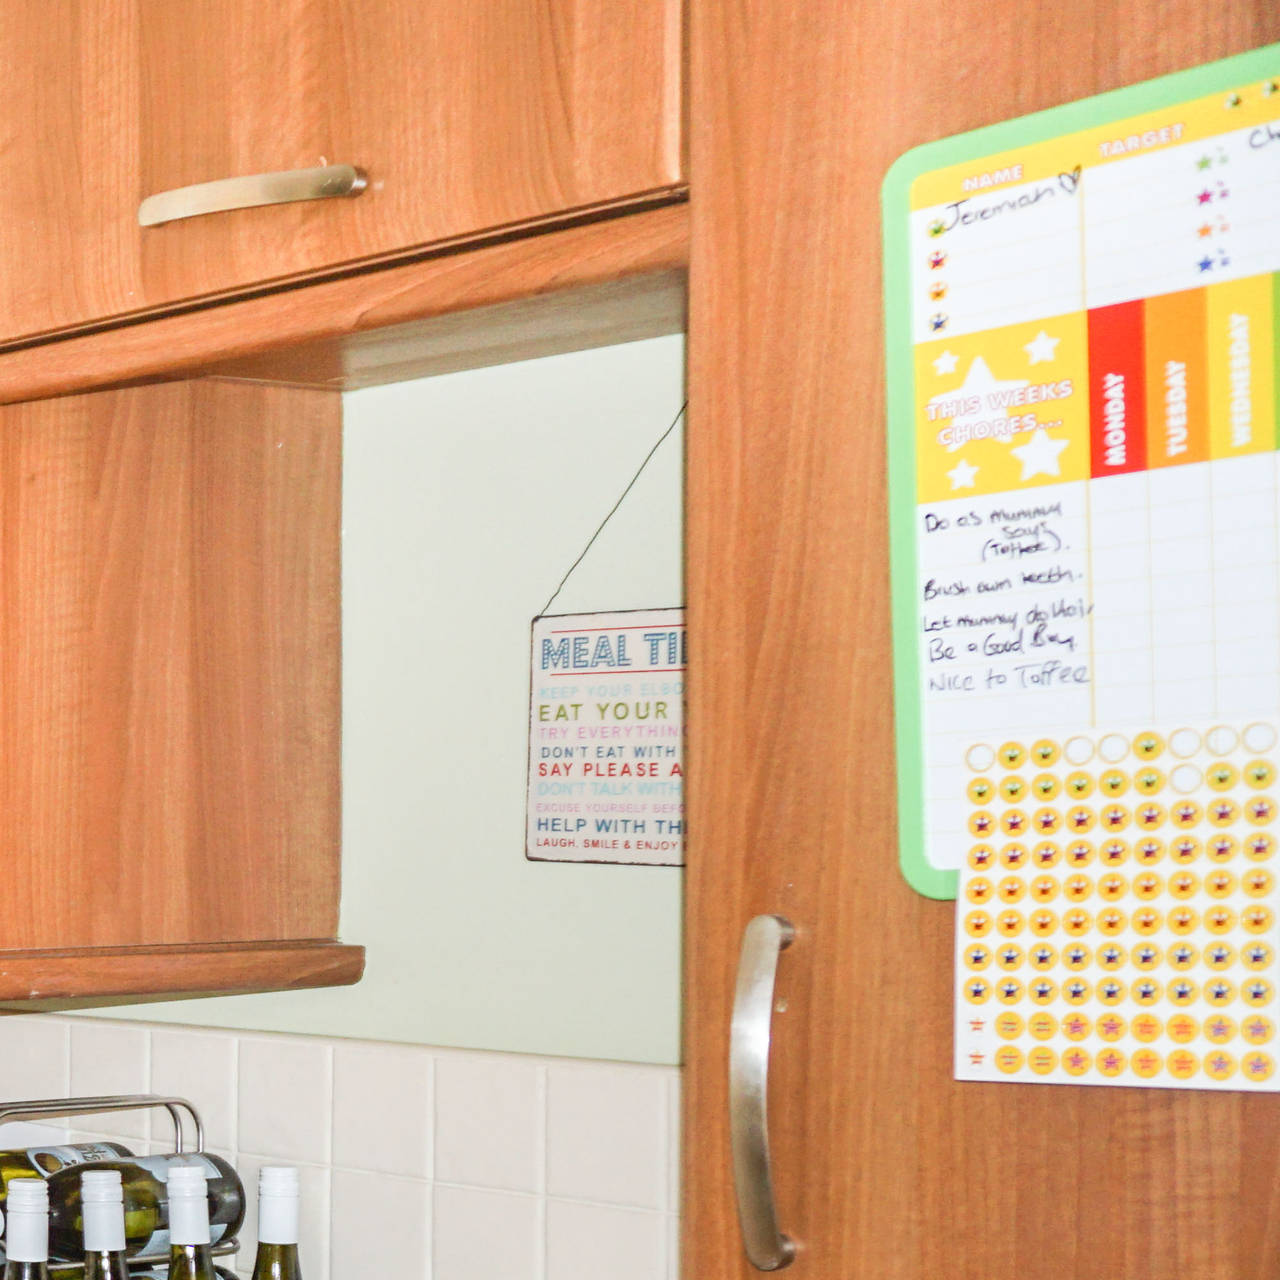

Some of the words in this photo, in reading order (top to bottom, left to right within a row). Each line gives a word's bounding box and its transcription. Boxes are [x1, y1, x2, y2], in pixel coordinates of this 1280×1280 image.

[962, 164, 1024, 192] NAME
[1098, 122, 1187, 159] TARGET
[924, 395, 981, 421] THIS
[986, 379, 1074, 410] WEEKS
[1165, 360, 1188, 457] TUESDAY
[1103, 372, 1127, 466] MONDAY
[924, 512, 950, 533] Do
[541, 634, 632, 670] MEAL
[643, 630, 688, 666] TI
[929, 637, 958, 663] Be
[985, 668, 1008, 689] to
[1014, 660, 1092, 688] Toffee
[540, 686, 578, 699] KEEP
[587, 684, 633, 697] YOUR
[539, 703, 584, 722] EAT
[596, 701, 668, 721] YOUR
[540, 727, 569, 739] TRY
[541, 746, 589, 758] DON'T
[596, 746, 625, 758] EAT
[634, 745, 676, 758] WITH
[538, 762, 573, 777] SAY
[583, 762, 659, 777] PLEASE
[537, 782, 586, 796] DON'T
[590, 782, 633, 795] TALK
[637, 782, 683, 795] WITH
[535, 802, 581, 813] EXCUSE
[586, 803, 648, 814] YOURSELF
[537, 817, 587, 833] HELP
[595, 819, 646, 834] WITH
[656, 820, 688, 835] TH
[583, 839, 619, 849] SMILE
[623, 840, 631, 849] &
[636, 840, 679, 851] ENJOY
